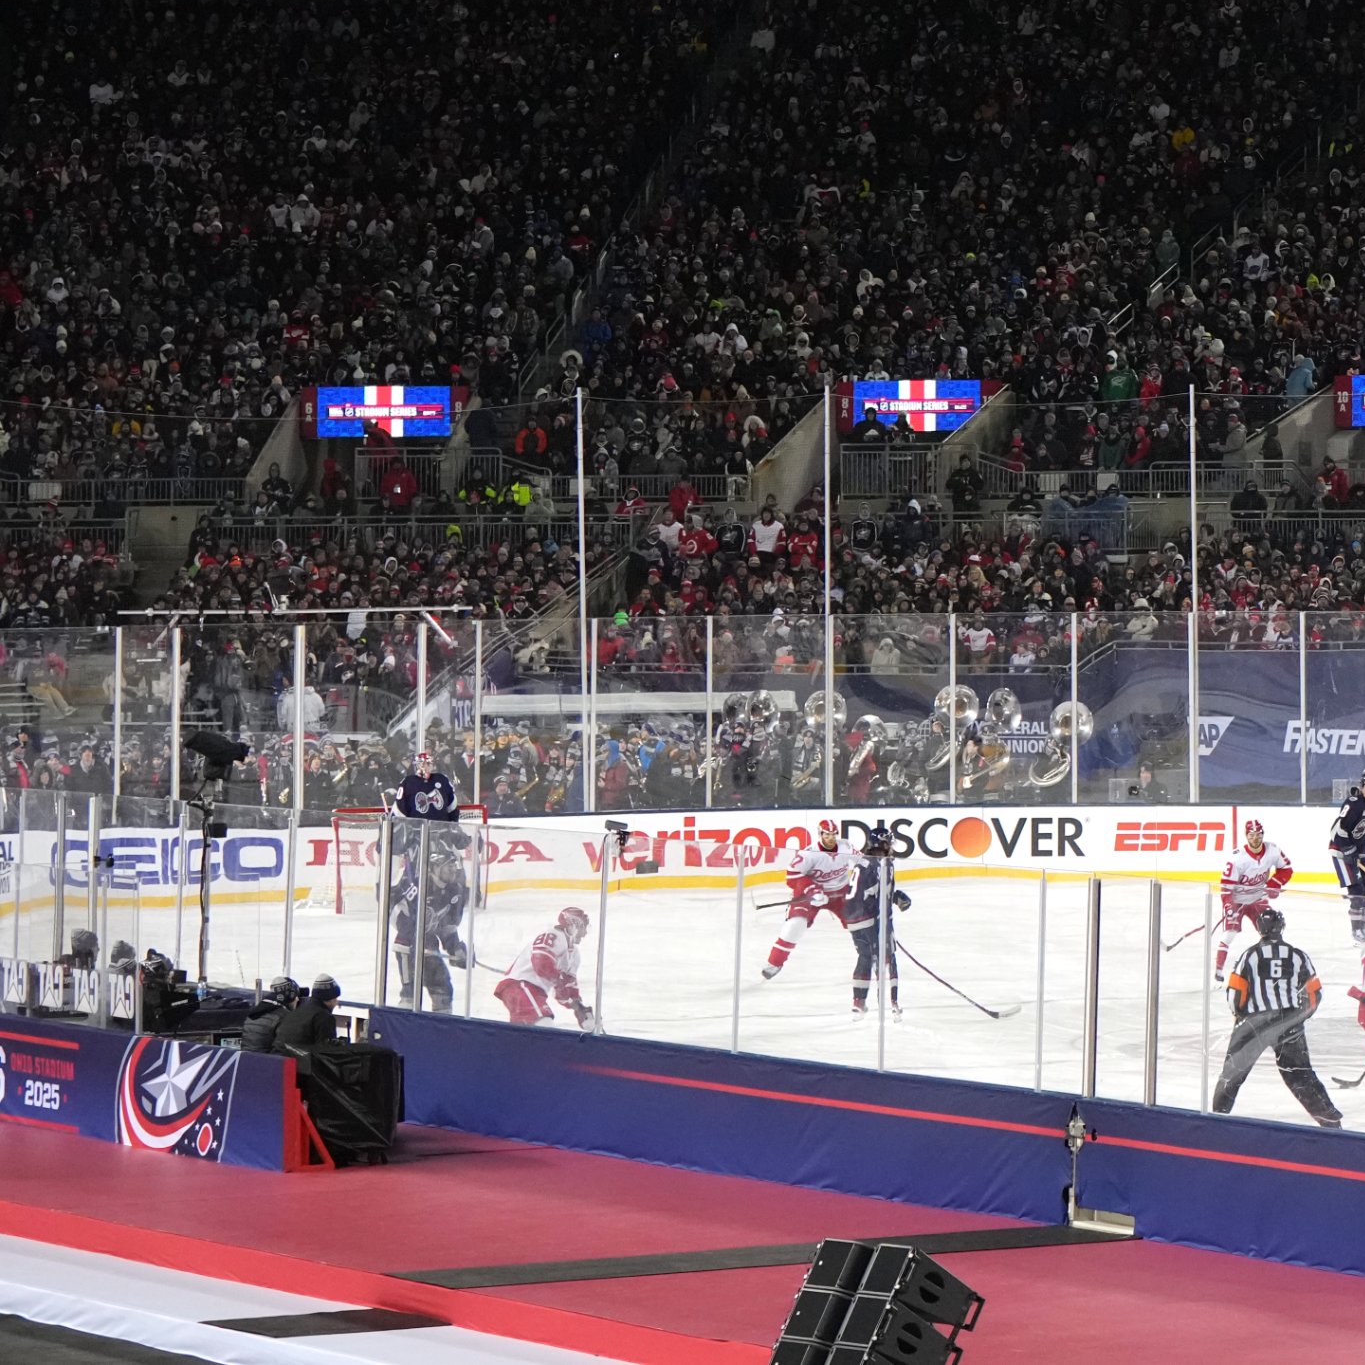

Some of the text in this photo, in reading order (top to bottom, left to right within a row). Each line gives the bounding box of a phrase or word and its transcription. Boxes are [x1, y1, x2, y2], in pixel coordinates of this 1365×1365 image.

[582, 816, 812, 873] verizon
[1114, 822, 1226, 852] ESPN
[50, 836, 284, 889] GEICO
[1269, 959, 1283, 979] 6
[11, 1052, 75, 1081] OHIO STADIUM
[24, 1079, 61, 1110] 2025
